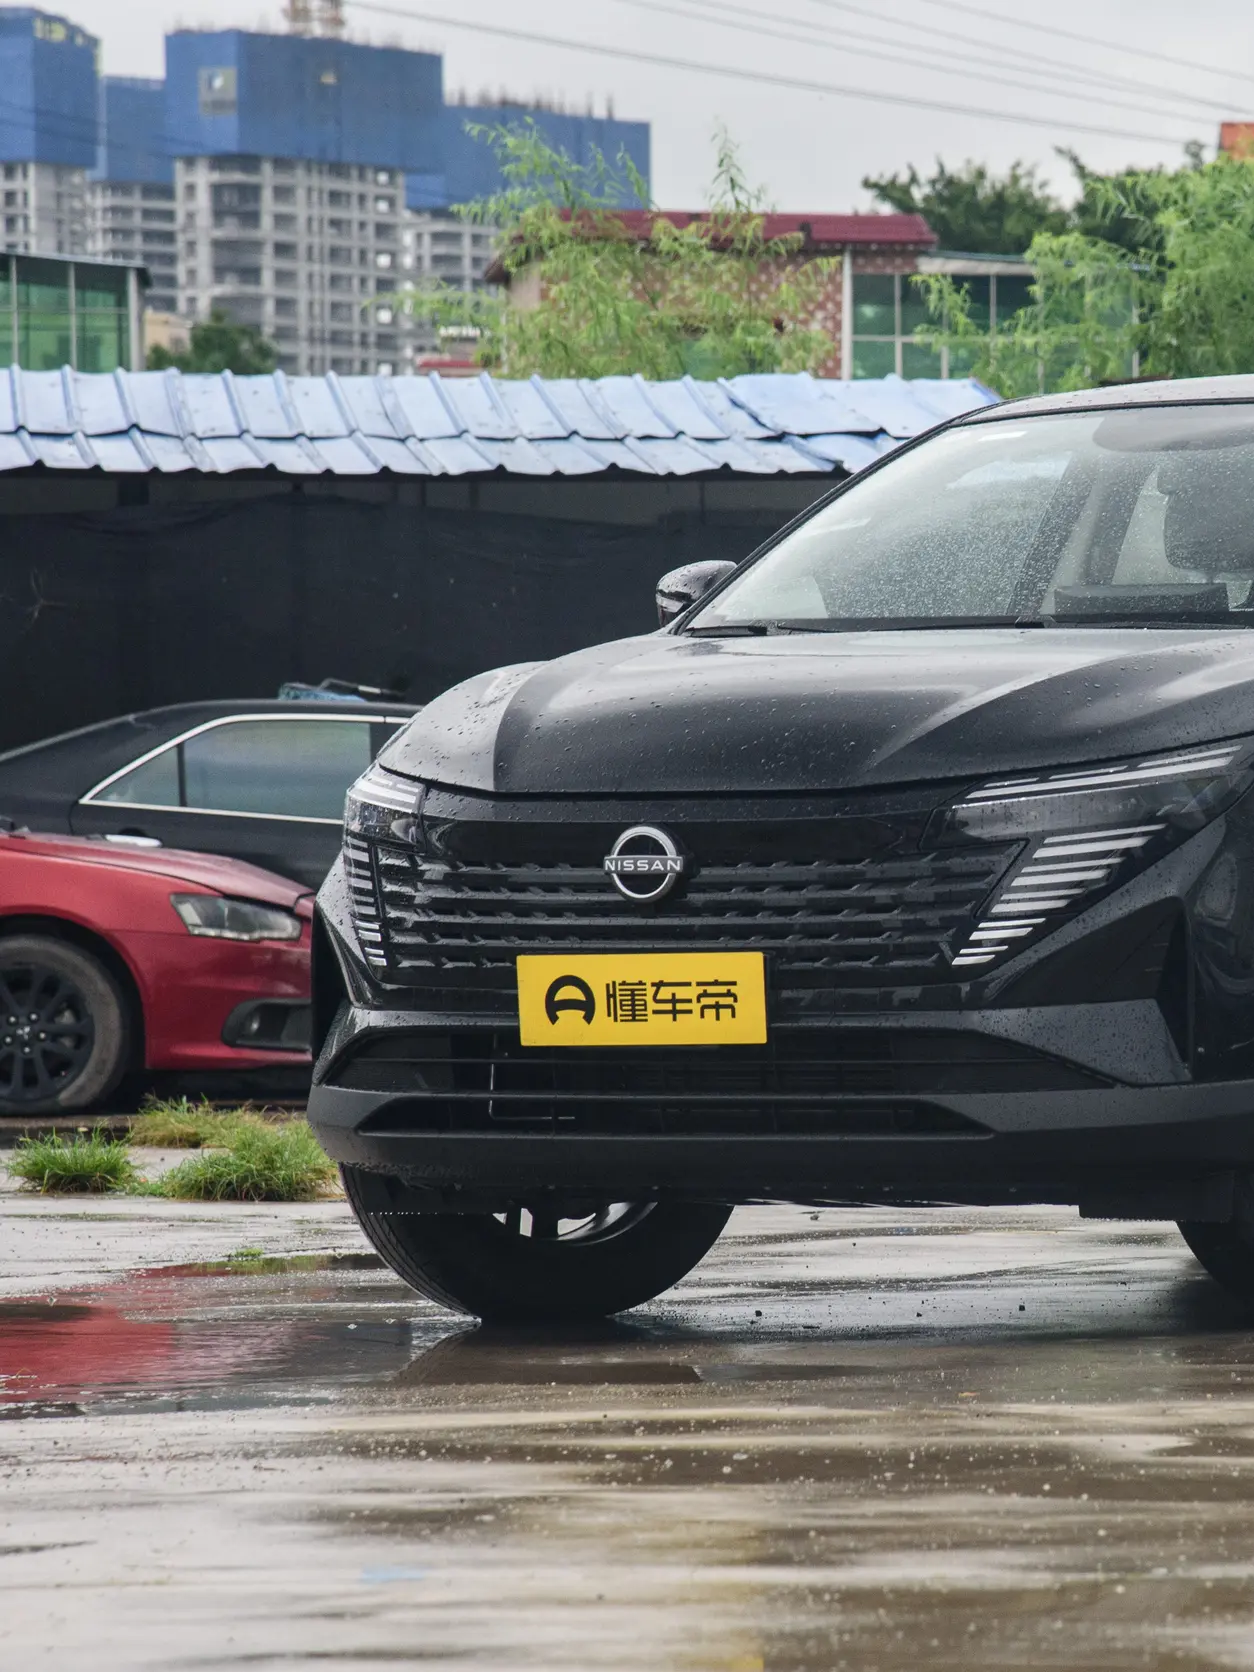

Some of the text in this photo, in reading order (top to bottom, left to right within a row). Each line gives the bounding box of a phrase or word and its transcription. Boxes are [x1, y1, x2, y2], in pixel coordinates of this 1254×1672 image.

[604, 859, 681, 872] NISSAN
[605, 979, 738, 1023] 懂车帝
